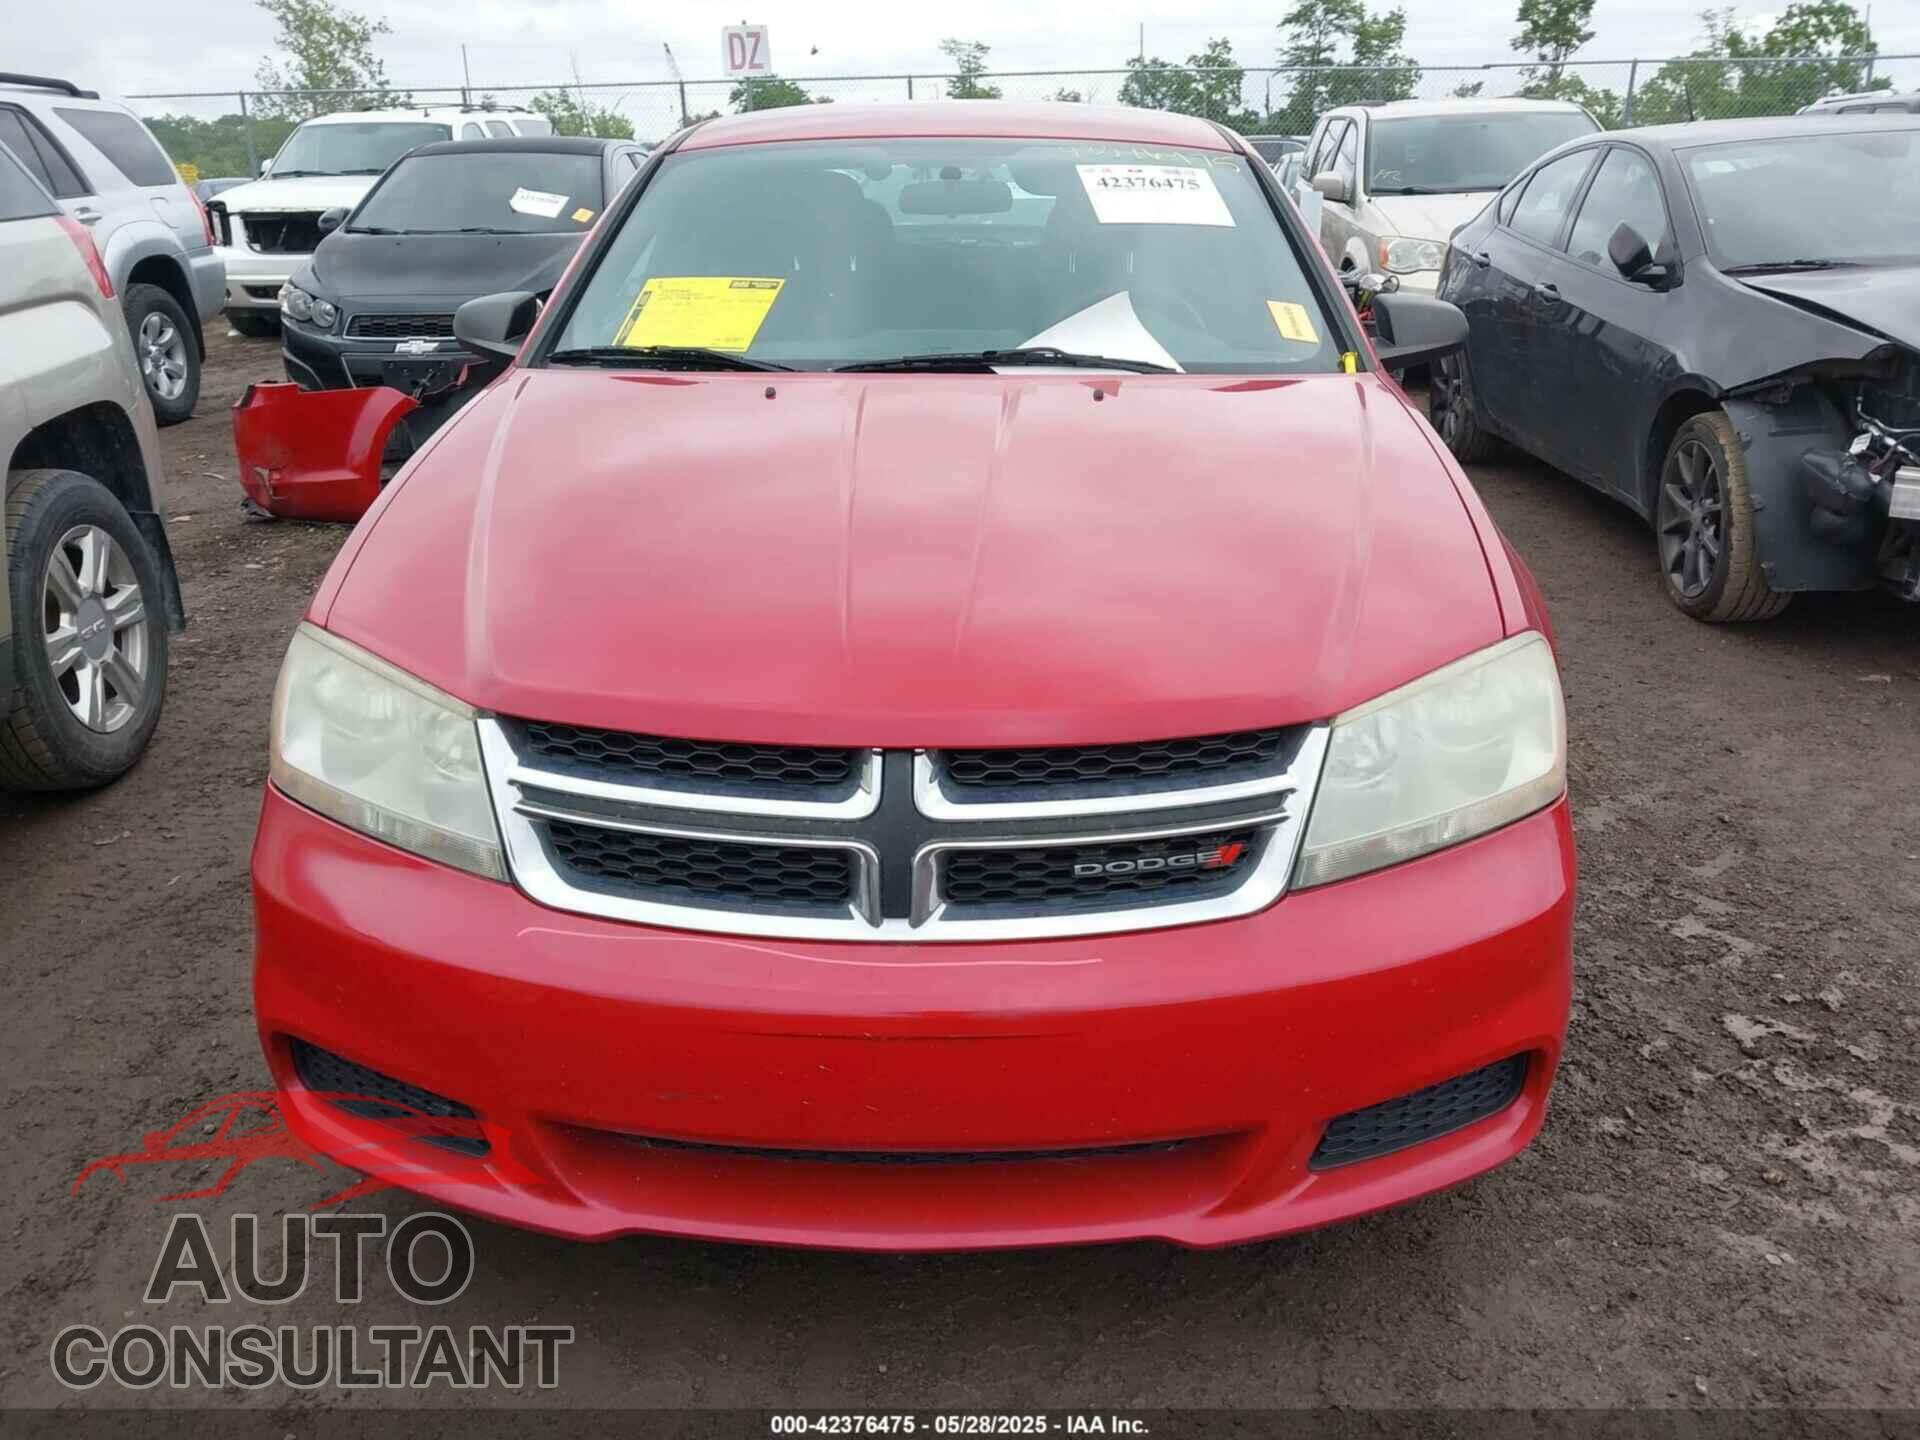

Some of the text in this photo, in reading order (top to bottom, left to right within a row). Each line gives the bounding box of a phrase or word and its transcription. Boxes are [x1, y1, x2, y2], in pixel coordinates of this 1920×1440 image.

[728, 31, 764, 70] DZ
[1097, 175, 1201, 191] 42376475
[1074, 850, 1221, 876] DODGE
